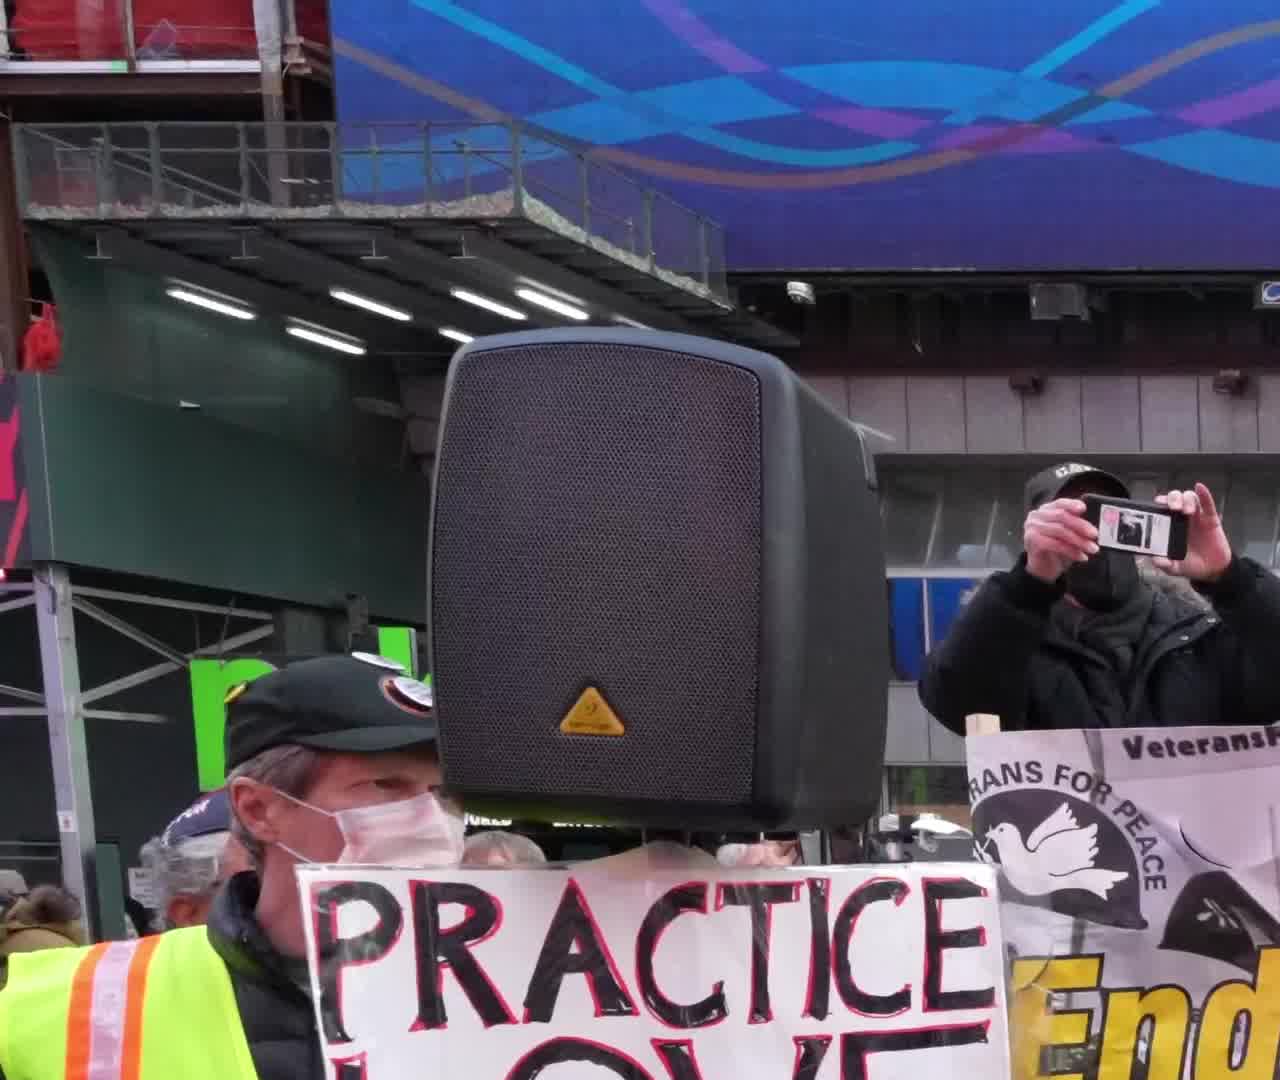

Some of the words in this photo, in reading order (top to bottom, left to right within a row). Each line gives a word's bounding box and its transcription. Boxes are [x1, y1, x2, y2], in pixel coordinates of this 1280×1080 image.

[1054, 764, 1112, 804] FOR
[1112, 800, 1167, 891] PEACE
[310, 876, 996, 1044] PRACTICE
